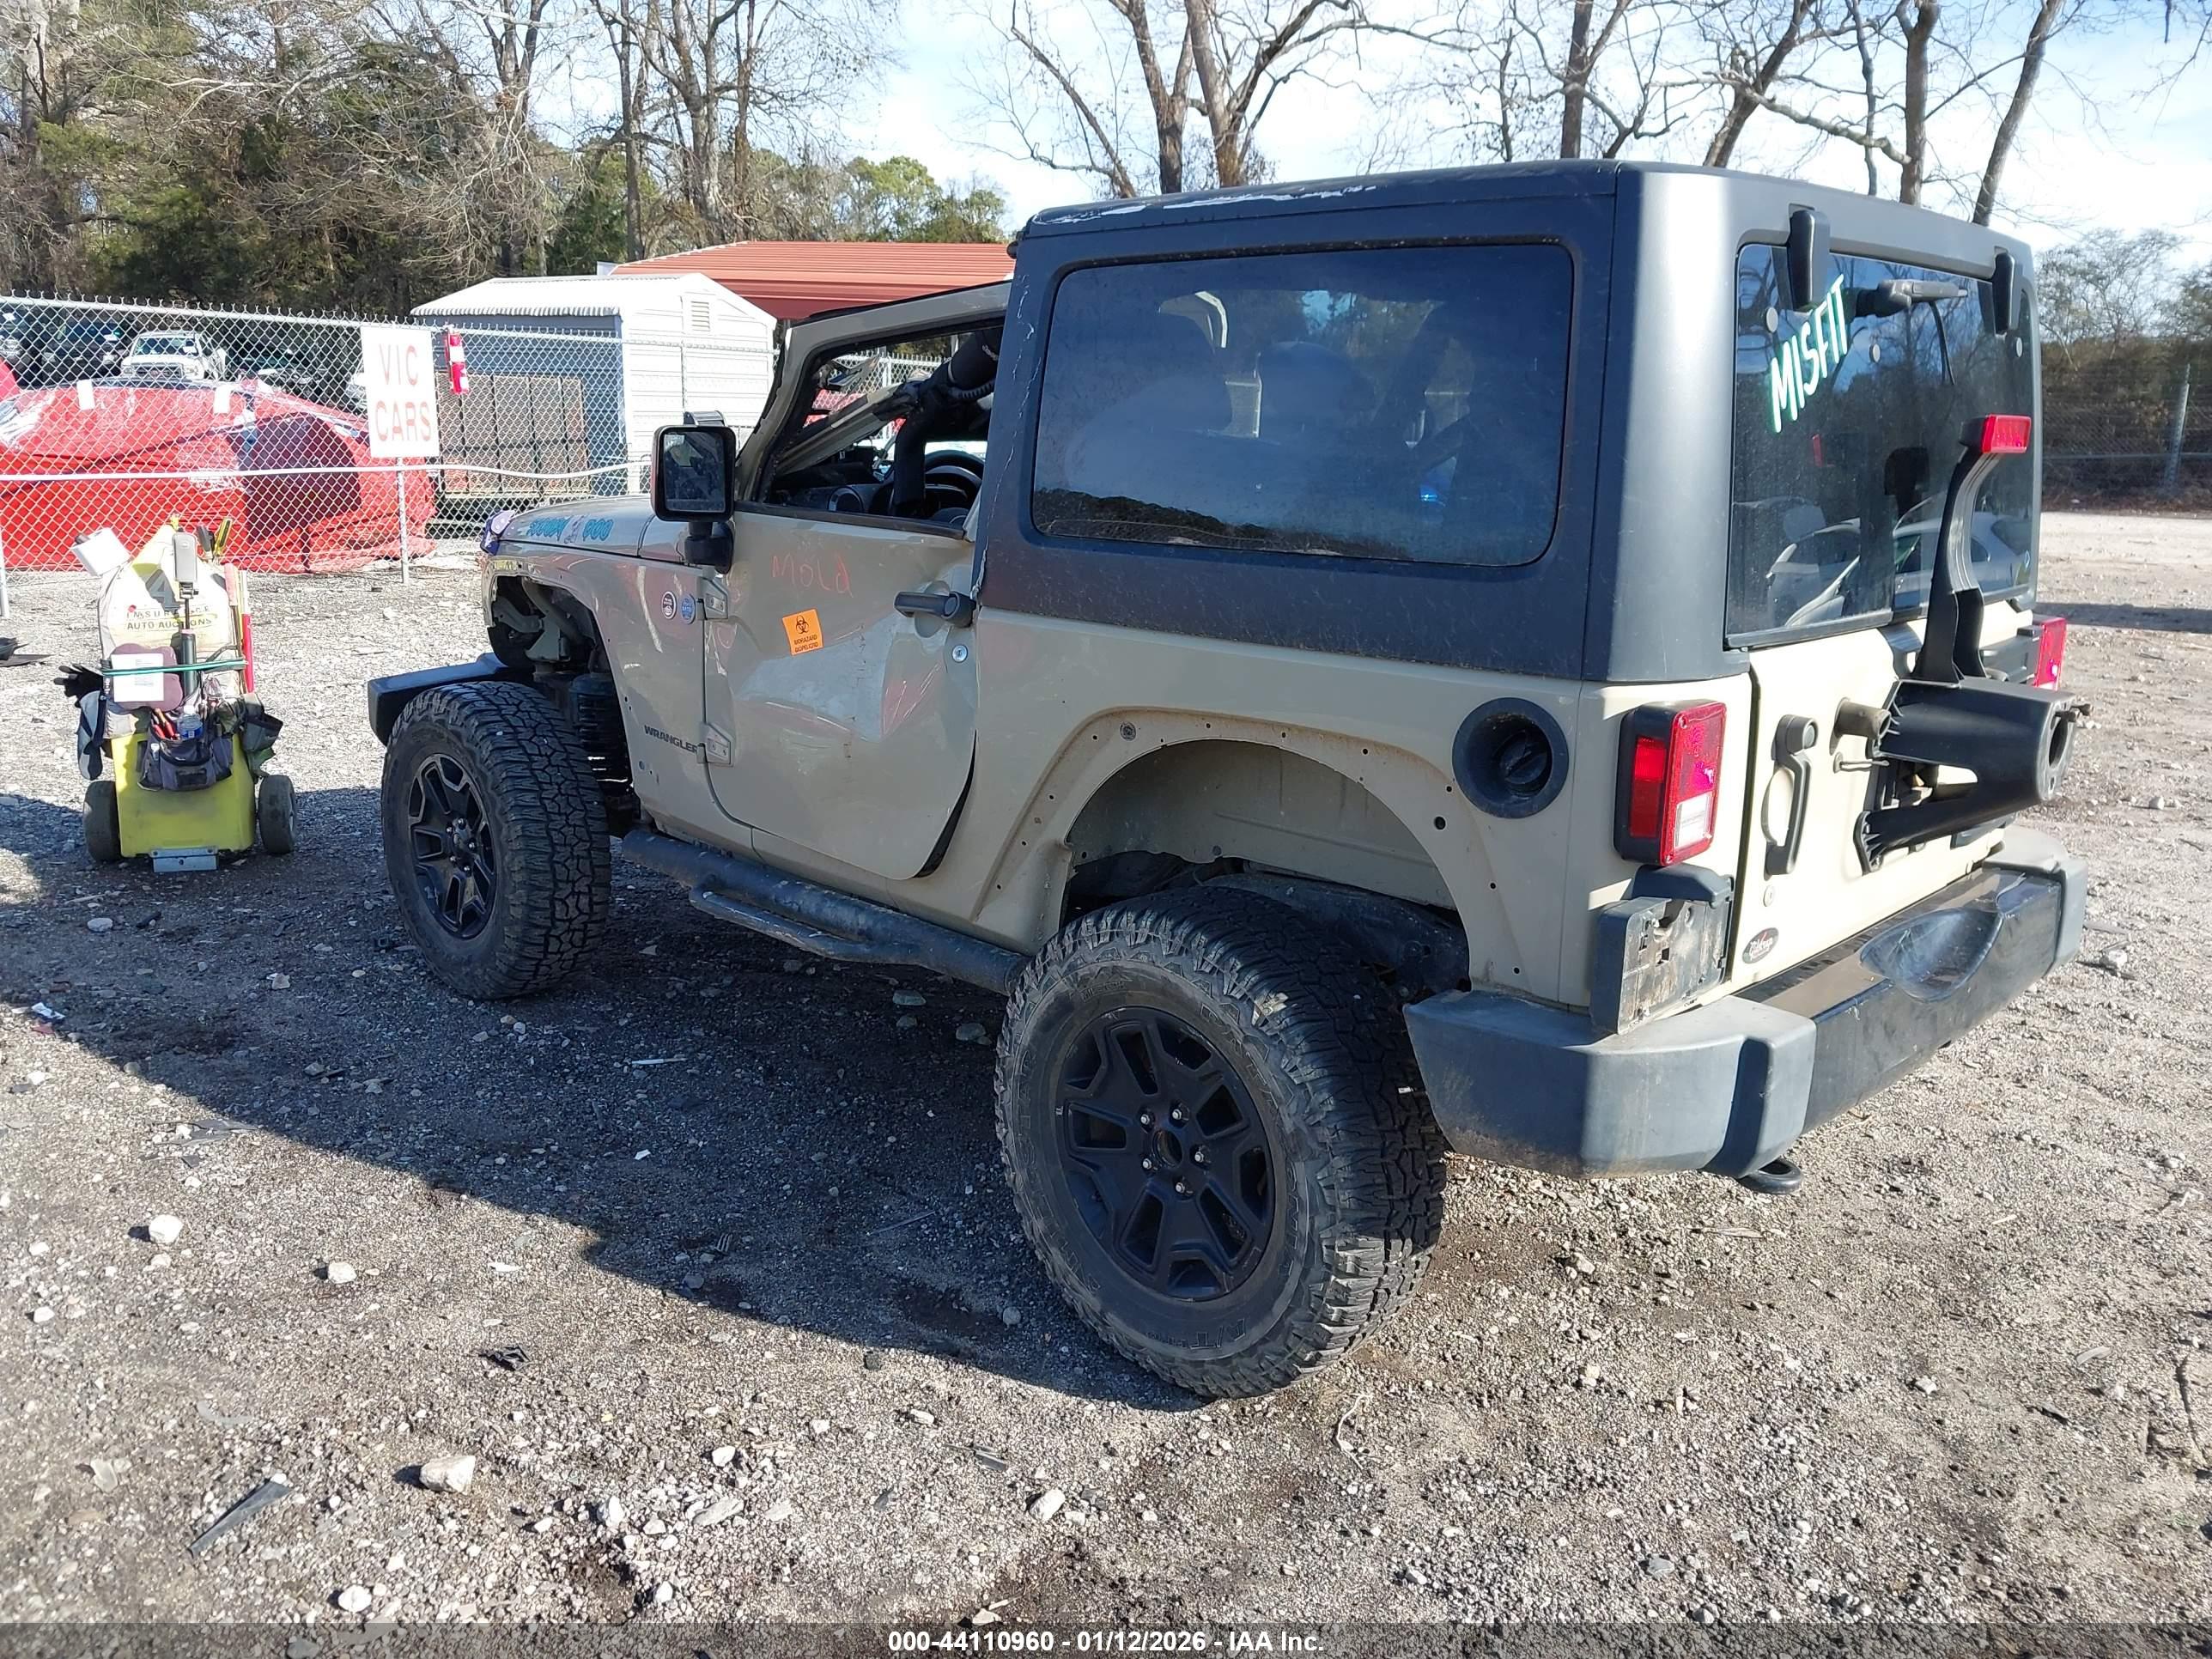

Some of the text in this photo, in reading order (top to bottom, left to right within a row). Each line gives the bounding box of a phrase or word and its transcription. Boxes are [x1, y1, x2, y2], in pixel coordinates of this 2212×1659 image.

[379, 343, 418, 386] VIC
[1771, 274, 1847, 433] MISFIT
[374, 399, 431, 442] CARS
[126, 605, 211, 619] INSURCE
[127, 617, 212, 630] AUTO AUCONS
[644, 725, 698, 755] WRANGLER
